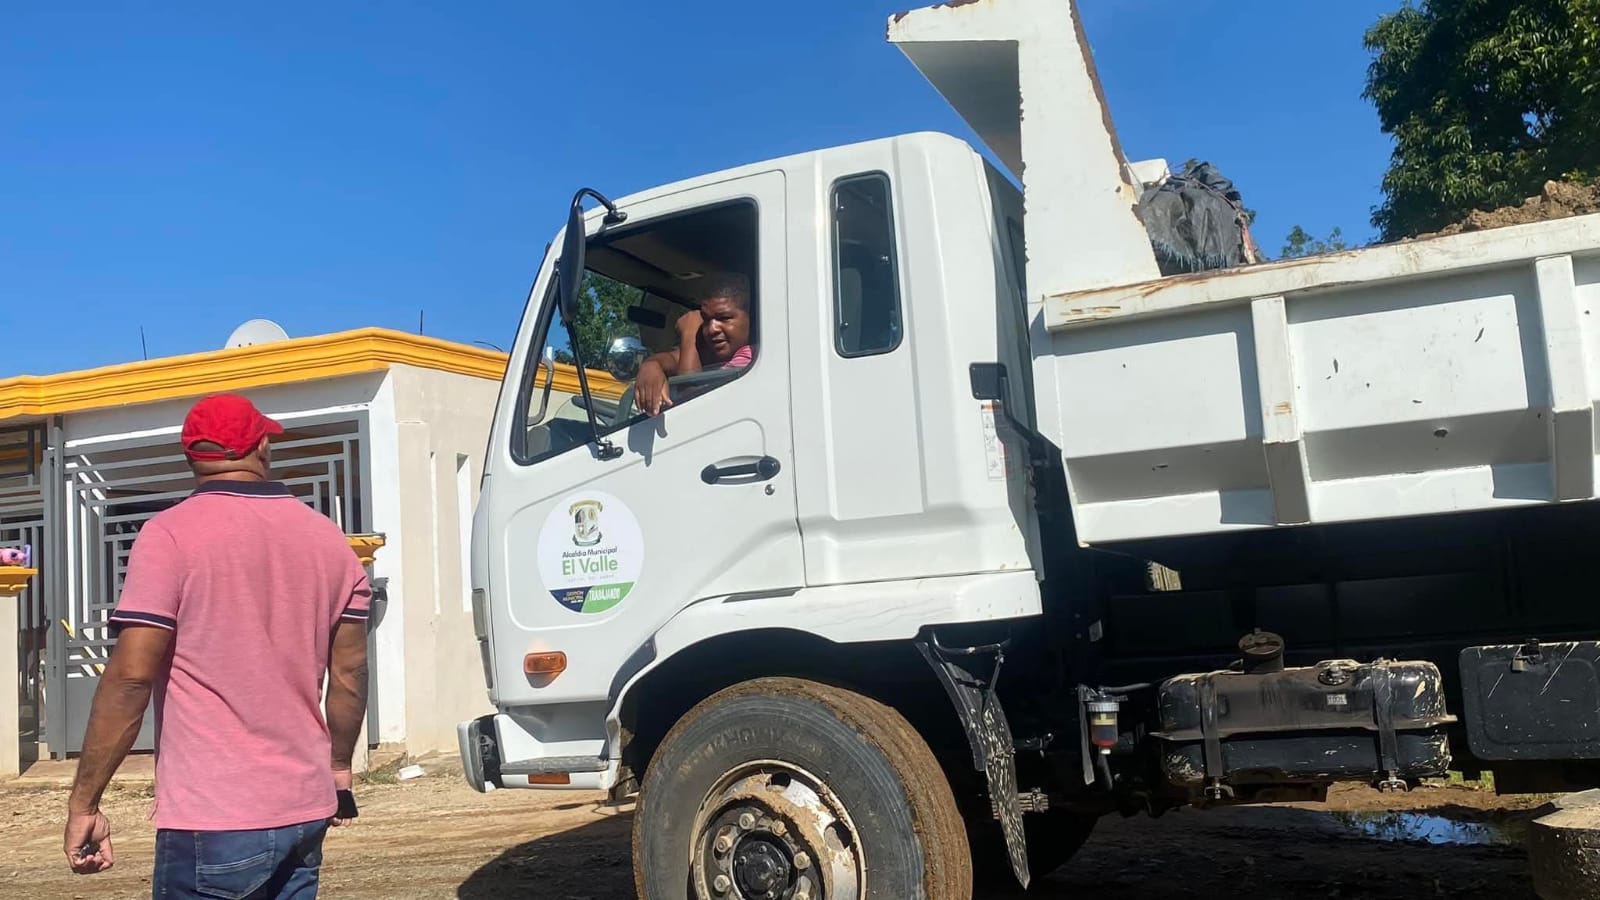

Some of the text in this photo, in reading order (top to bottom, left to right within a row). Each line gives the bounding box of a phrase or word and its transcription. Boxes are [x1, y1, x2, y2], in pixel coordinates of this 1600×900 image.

[588, 546, 618, 555] Municipal
[562, 556, 618, 575] El Valle
